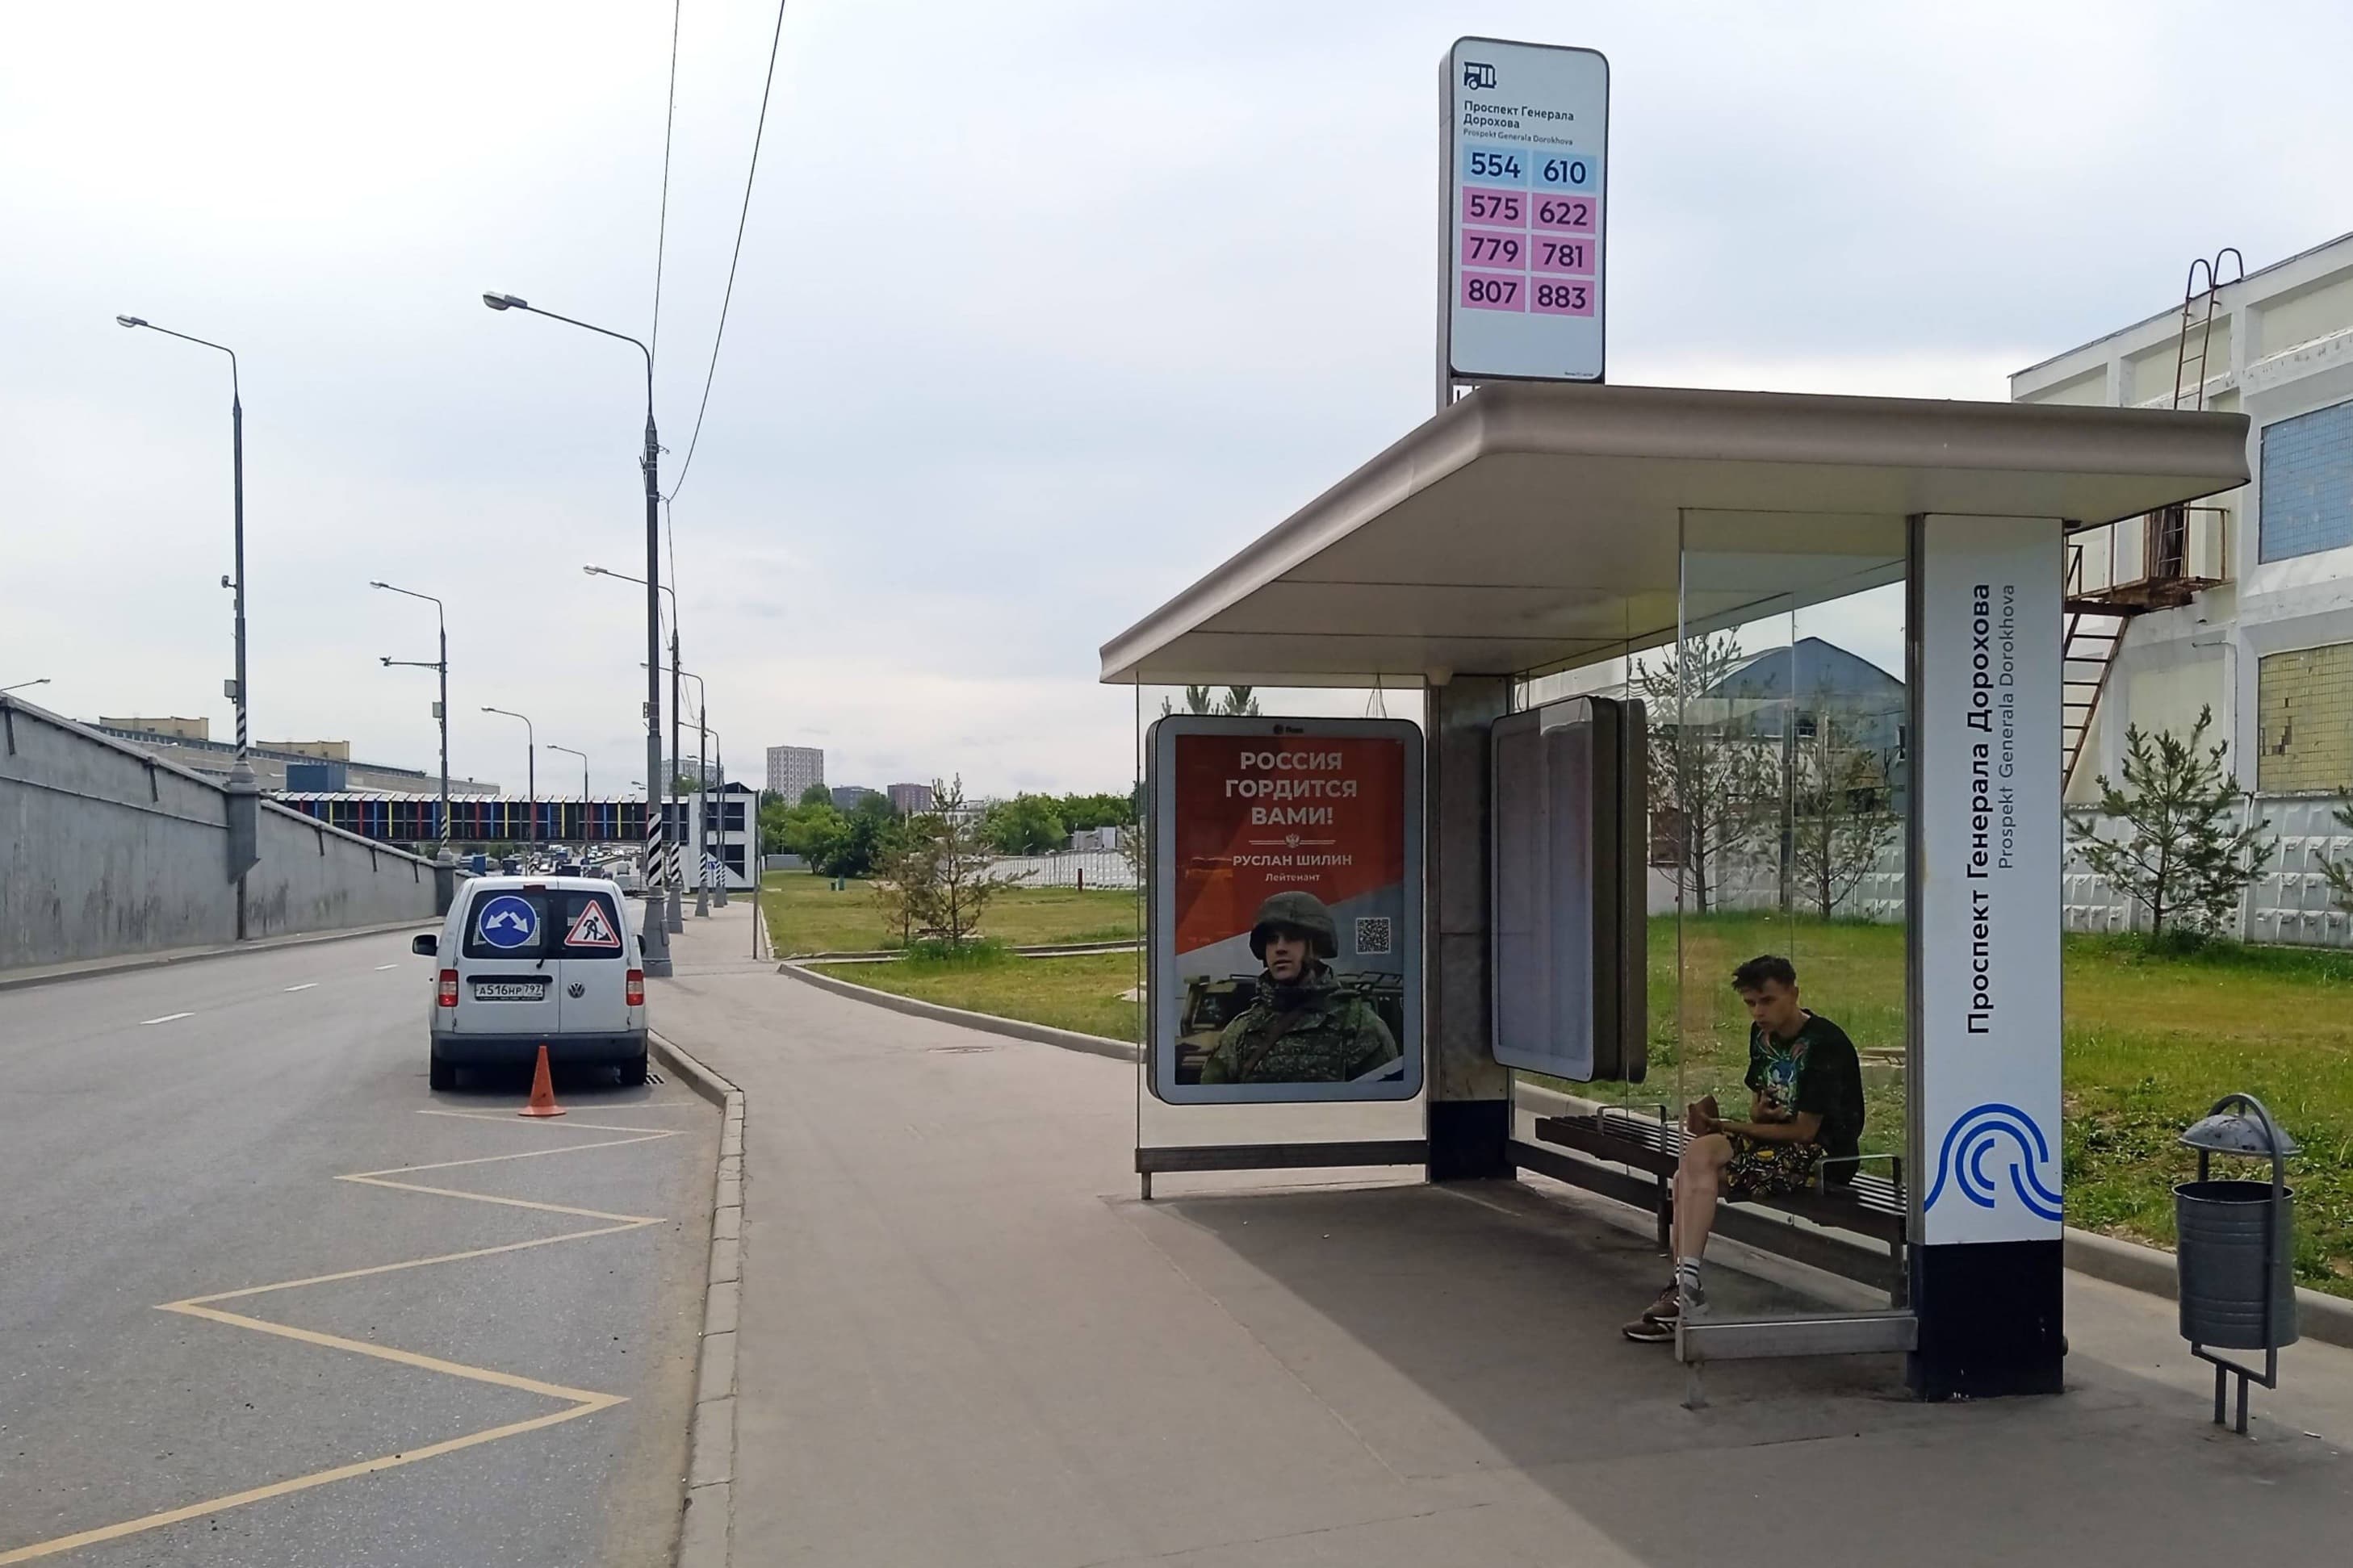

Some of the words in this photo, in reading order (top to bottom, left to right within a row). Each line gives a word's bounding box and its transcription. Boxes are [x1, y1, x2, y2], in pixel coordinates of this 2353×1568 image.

[1463, 100, 1518, 116] Проспект
[1521, 107, 1574, 121] Генерала
[1463, 114, 1520, 129] Дорохова
[1463, 128, 1497, 139] Prospekt
[1497, 132, 1531, 142] Generala
[1533, 136, 1573, 146] Dorokhova
[1470, 152, 1521, 178] 554
[1543, 159, 1586, 184] 610
[1470, 194, 1519, 220] 575
[1539, 201, 1588, 226] 622
[1470, 236, 1519, 262] 779
[1543, 243, 1583, 268] 781
[1468, 279, 1518, 304] 807
[1538, 284, 1586, 310] 883
[1999, 584, 2015, 687] Dorokhova
[1966, 583, 1994, 733] Дорохова
[1999, 693, 2015, 778] Generala
[1241, 752, 1342, 771] РОССИЯ
[1225, 780, 1357, 801] ГОРДИТСЯ
[1251, 807, 1334, 825] ВАМИ!
[1966, 742, 1994, 880] Генерала
[1999, 785, 2019, 869] Prospekt
[1233, 855, 1292, 866] РУСЛАН
[1296, 855, 1352, 866] ШИЛИН
[1265, 873, 1321, 882] Лейтенант
[1967, 889, 1994, 1035] Проспект
